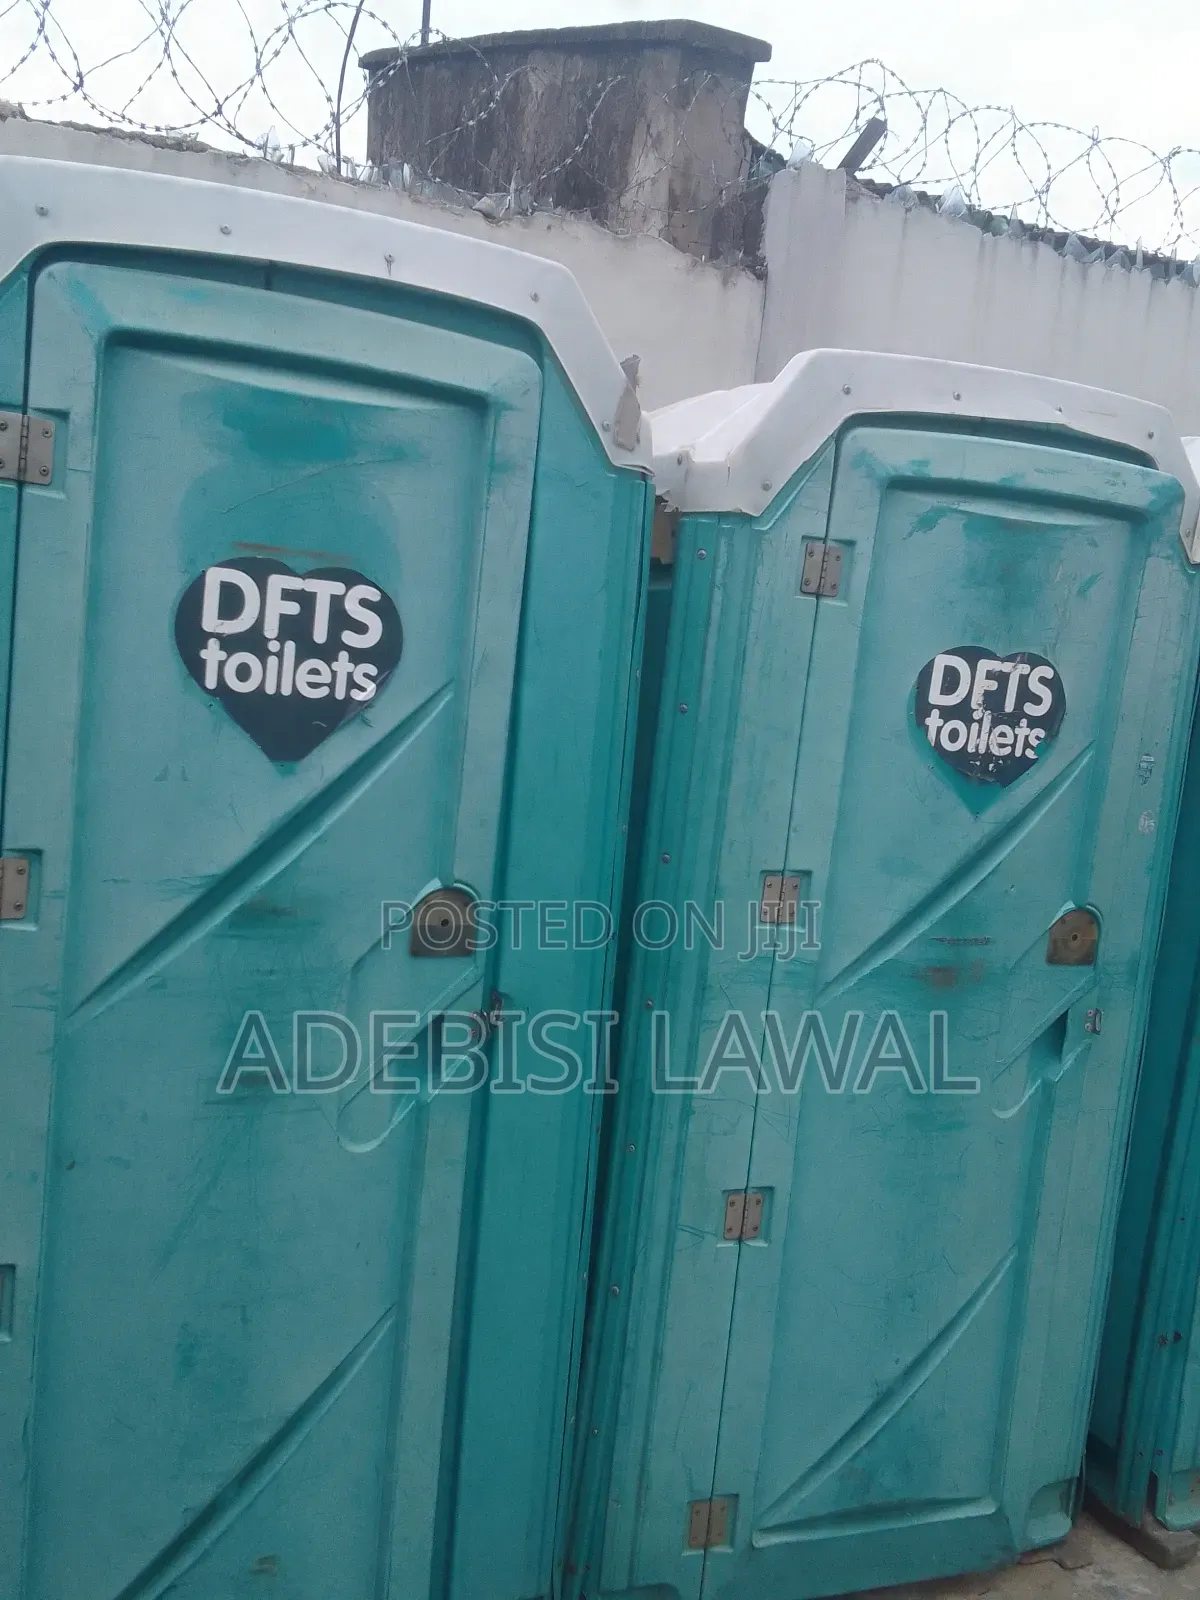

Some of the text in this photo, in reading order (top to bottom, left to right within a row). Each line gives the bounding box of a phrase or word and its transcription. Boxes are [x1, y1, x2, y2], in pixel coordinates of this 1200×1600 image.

[201, 566, 383, 649] DFTS
[200, 637, 378, 702] toilets
[928, 654, 1054, 717] DFTS
[924, 708, 1046, 759] toilets
